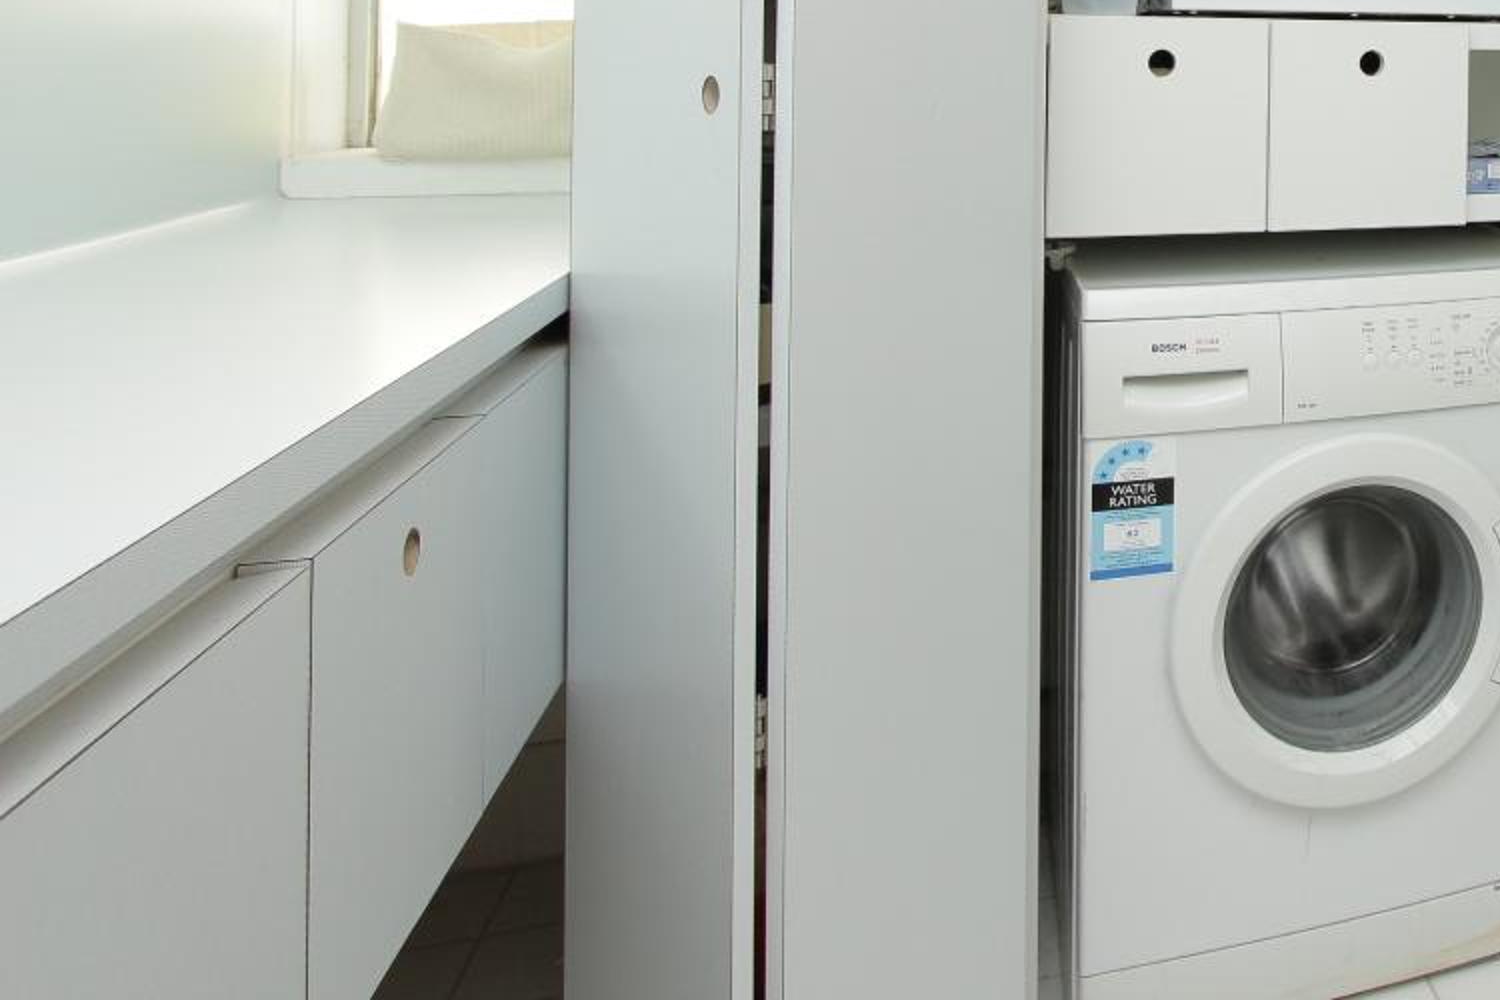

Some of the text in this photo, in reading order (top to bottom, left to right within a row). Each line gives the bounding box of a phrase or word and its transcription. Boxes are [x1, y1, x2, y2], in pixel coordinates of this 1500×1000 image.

[1152, 343, 1187, 353] BOSCH
[1111, 483, 1156, 496] WATER
[1109, 494, 1157, 508] RATING
